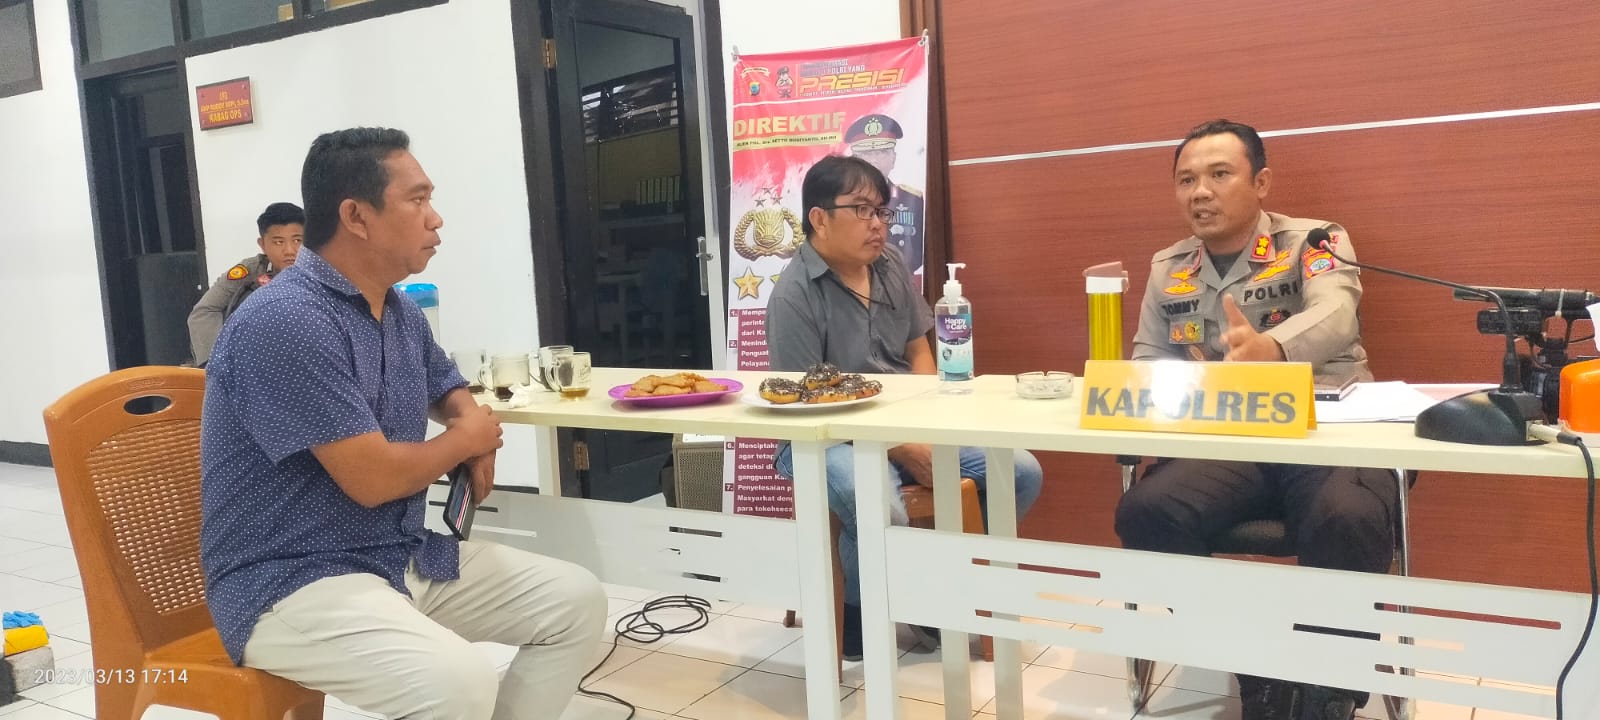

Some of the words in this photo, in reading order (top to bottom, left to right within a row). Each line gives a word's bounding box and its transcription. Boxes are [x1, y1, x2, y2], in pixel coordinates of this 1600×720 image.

[800, 68, 905, 94] PRESISI
[734, 112, 846, 136] DIREKTIF
[1244, 281, 1299, 302] POLRI
[1162, 299, 1199, 316] TOMMY
[944, 317, 967, 327] Happy
[737, 474, 773, 482] gangguan
[737, 484, 785, 492] Penyelesaian
[737, 494, 775, 503] Masyarkat
